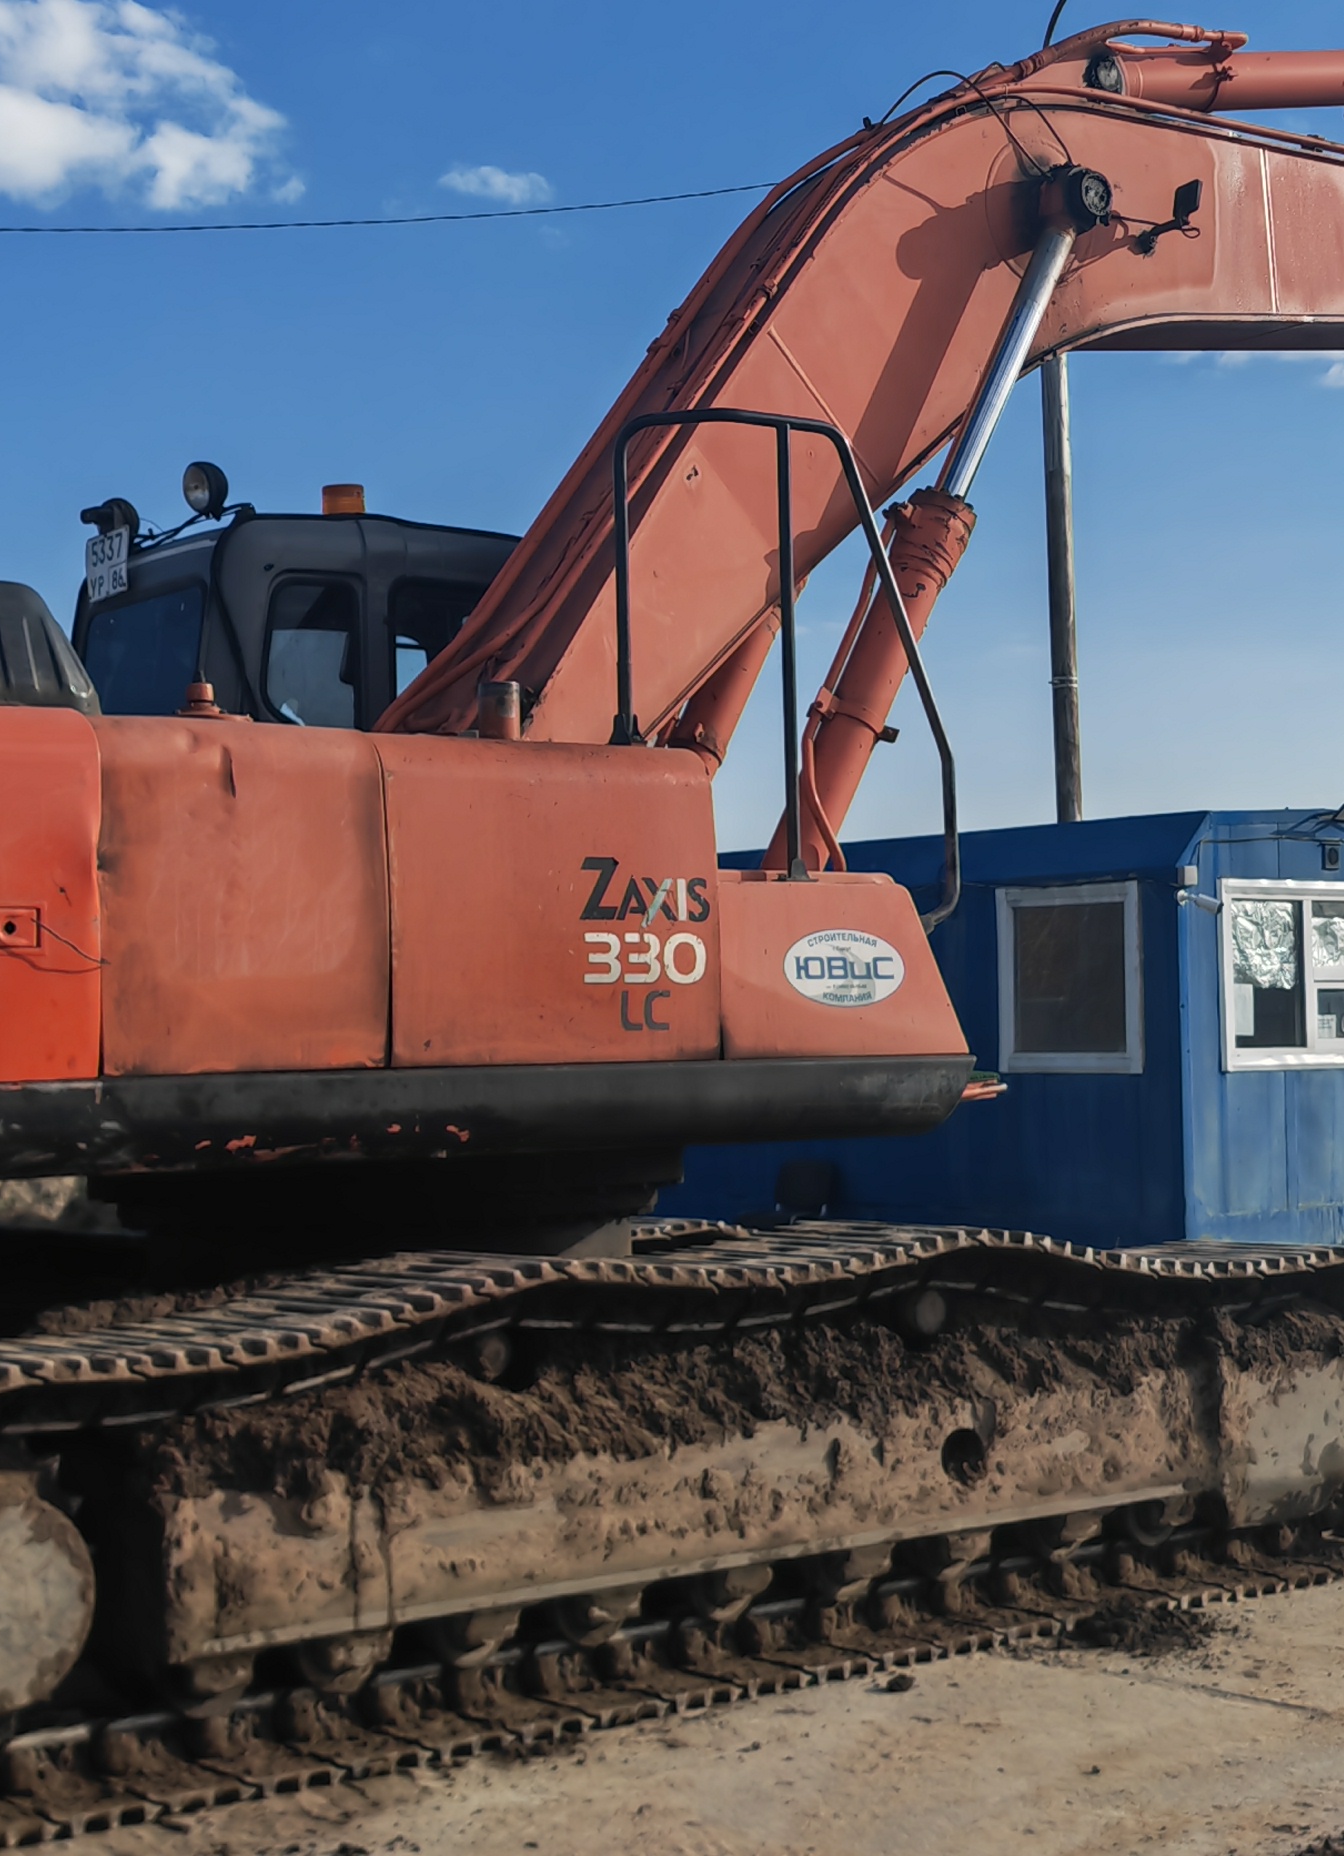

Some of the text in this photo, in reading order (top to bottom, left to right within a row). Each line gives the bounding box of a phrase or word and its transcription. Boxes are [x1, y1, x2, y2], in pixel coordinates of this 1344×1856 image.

[91, 532, 123, 567] 5337
[111, 568, 125, 590] 86
[807, 932, 878, 947] СТРОИТЕЛЬНАЯ
[583, 932, 706, 984] 330
[621, 990, 670, 1031] LC
[822, 991, 872, 1003] КОМПАНИЯ
